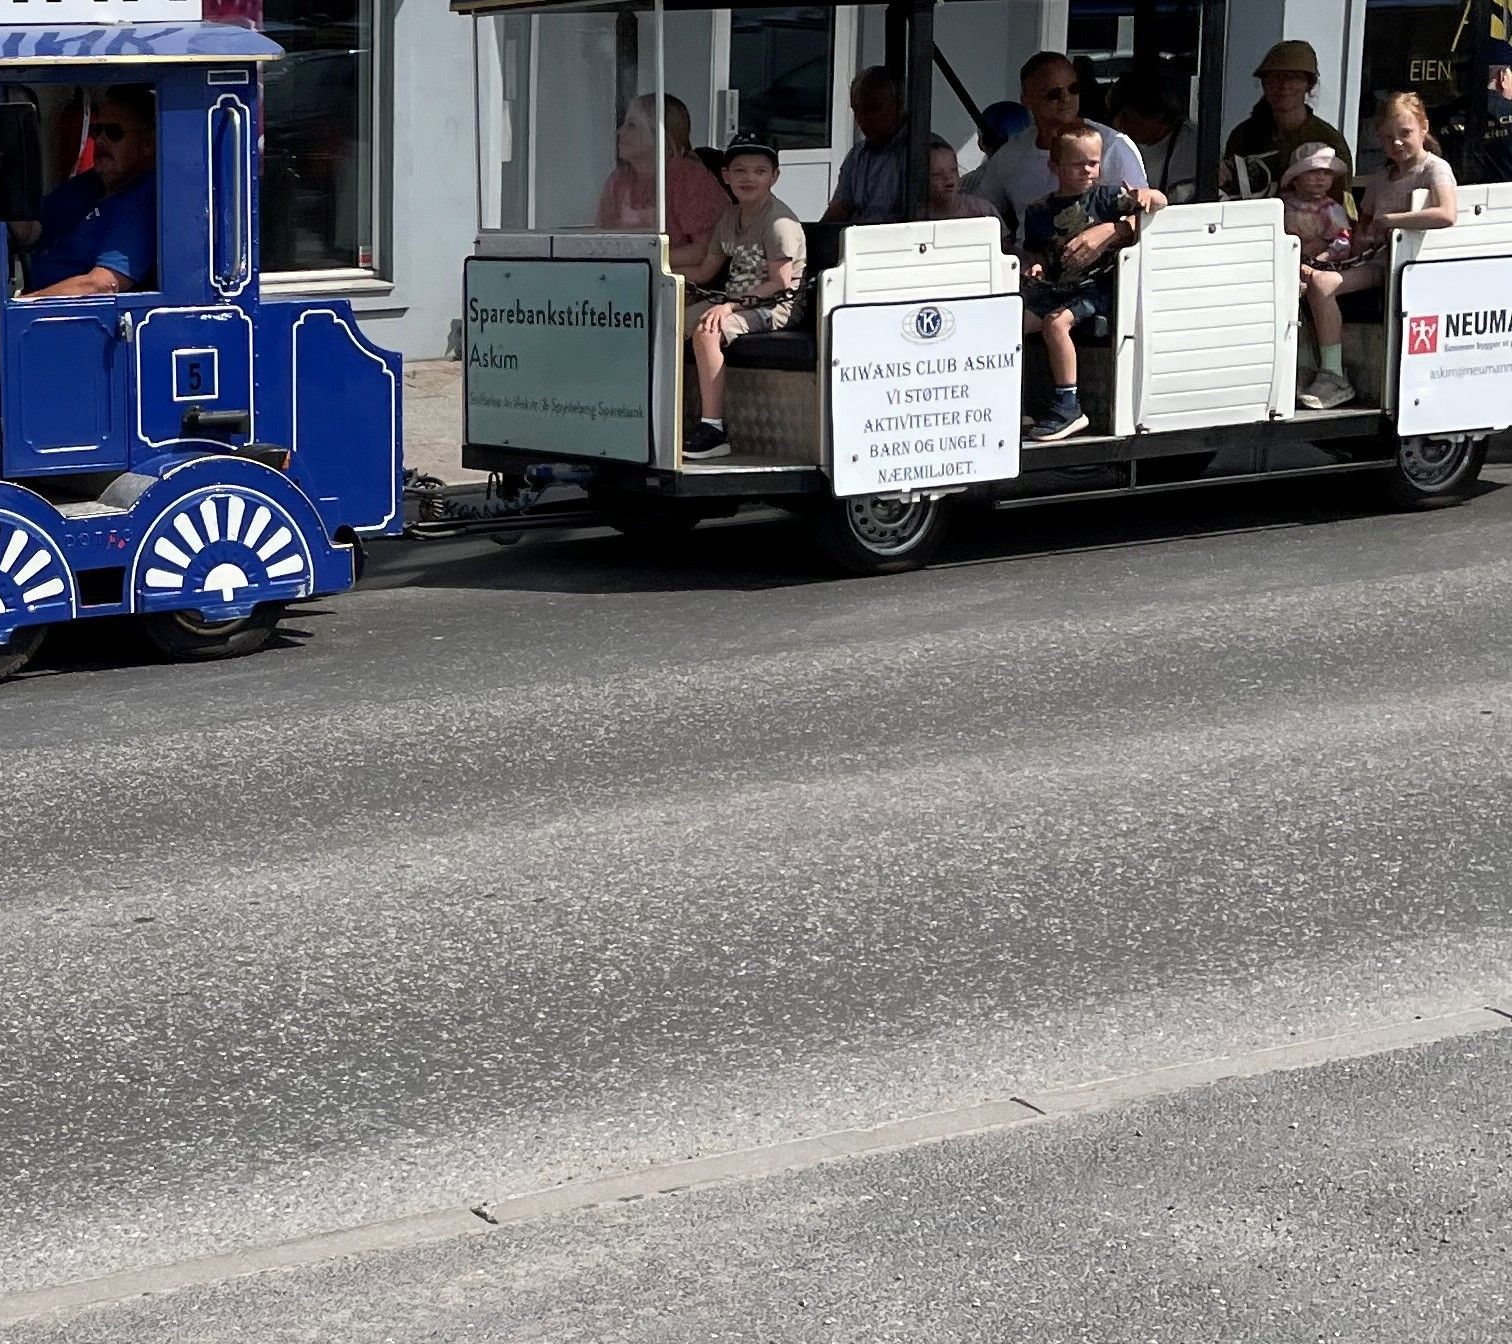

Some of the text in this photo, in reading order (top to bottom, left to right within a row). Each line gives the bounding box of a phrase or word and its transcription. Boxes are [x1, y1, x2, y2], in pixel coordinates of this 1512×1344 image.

[469, 297, 645, 333] Sparebankstiftelsen
[1445, 309, 1512, 338] NEUM
[469, 343, 519, 371] Askim
[840, 353, 1015, 382] KIWANIS CLUB ASKIM
[189, 362, 201, 390] 5
[886, 385, 969, 405] VI STØTTER
[863, 408, 992, 433] AKTIVITETER FOR
[870, 434, 986, 458] BARN OG UNGE I
[878, 461, 976, 484] NÆRMILJØET.
